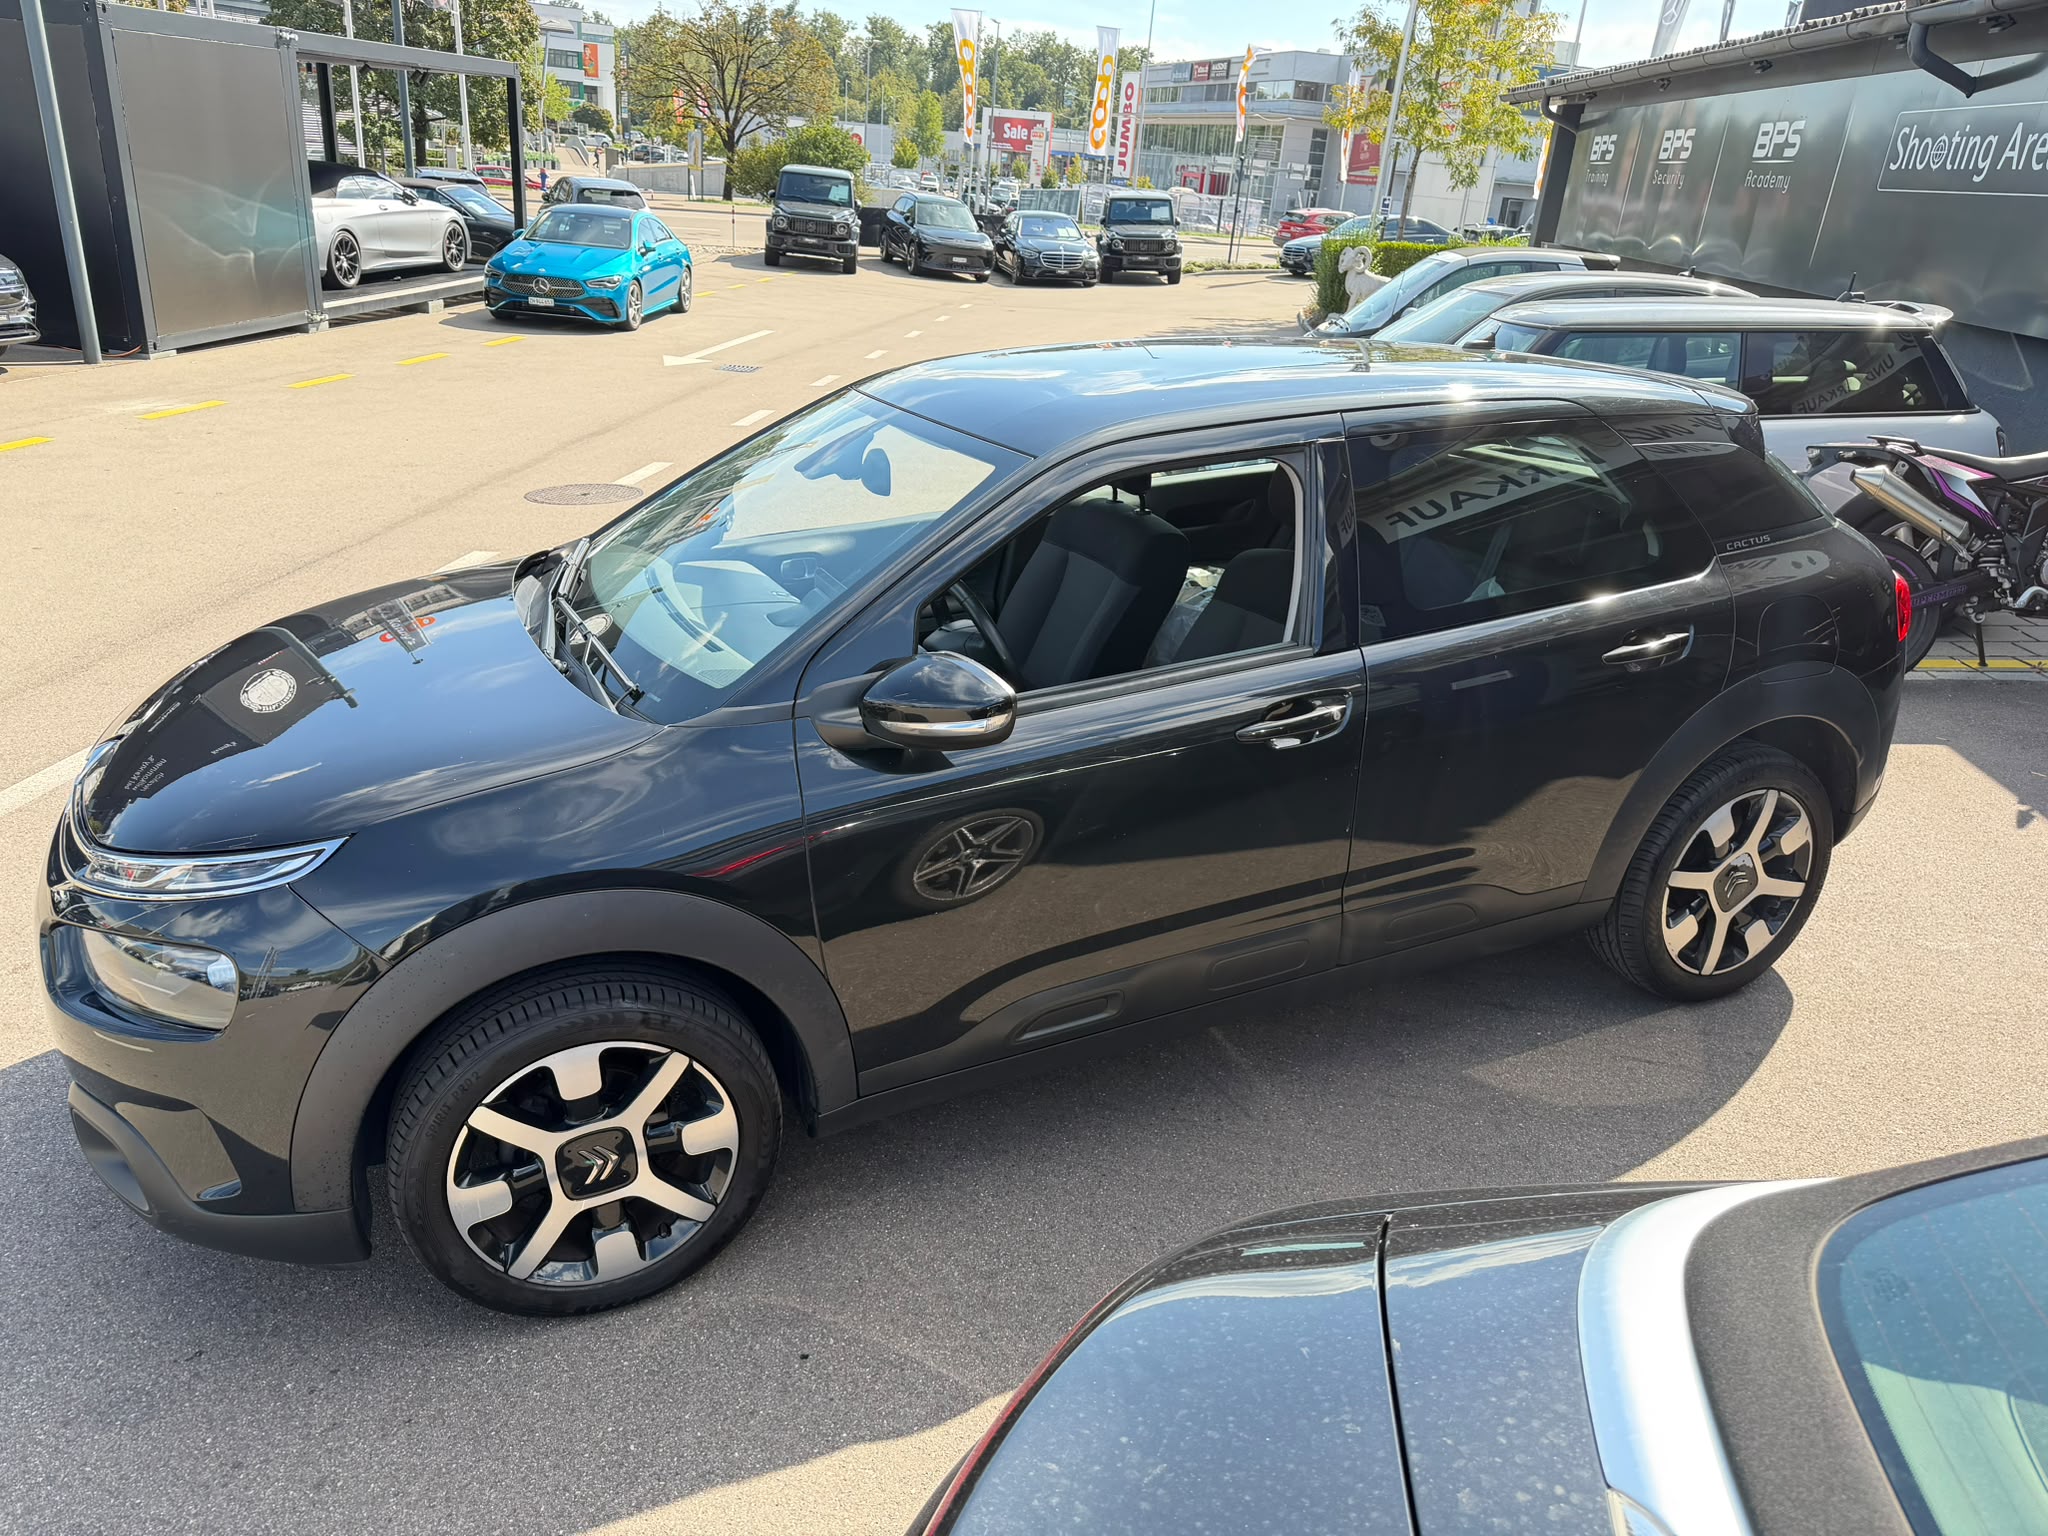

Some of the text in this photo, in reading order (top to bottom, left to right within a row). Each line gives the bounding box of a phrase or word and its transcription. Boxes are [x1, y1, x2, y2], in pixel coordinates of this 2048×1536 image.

[1089, 54, 1115, 150] coop
[1003, 122, 1028, 140] Sale
[1117, 81, 1135, 172] JUMBO
[1752, 120, 1806, 158] BPS
[1590, 134, 1618, 161] BPS
[1658, 128, 1696, 160] BPS
[1889, 121, 2048, 183] Shooting Are
[1652, 169, 1685, 190] Security
[1744, 169, 1792, 194] Academy
[1726, 534, 1771, 551] CACTUS
[451, 1078, 473, 1101] PRO
